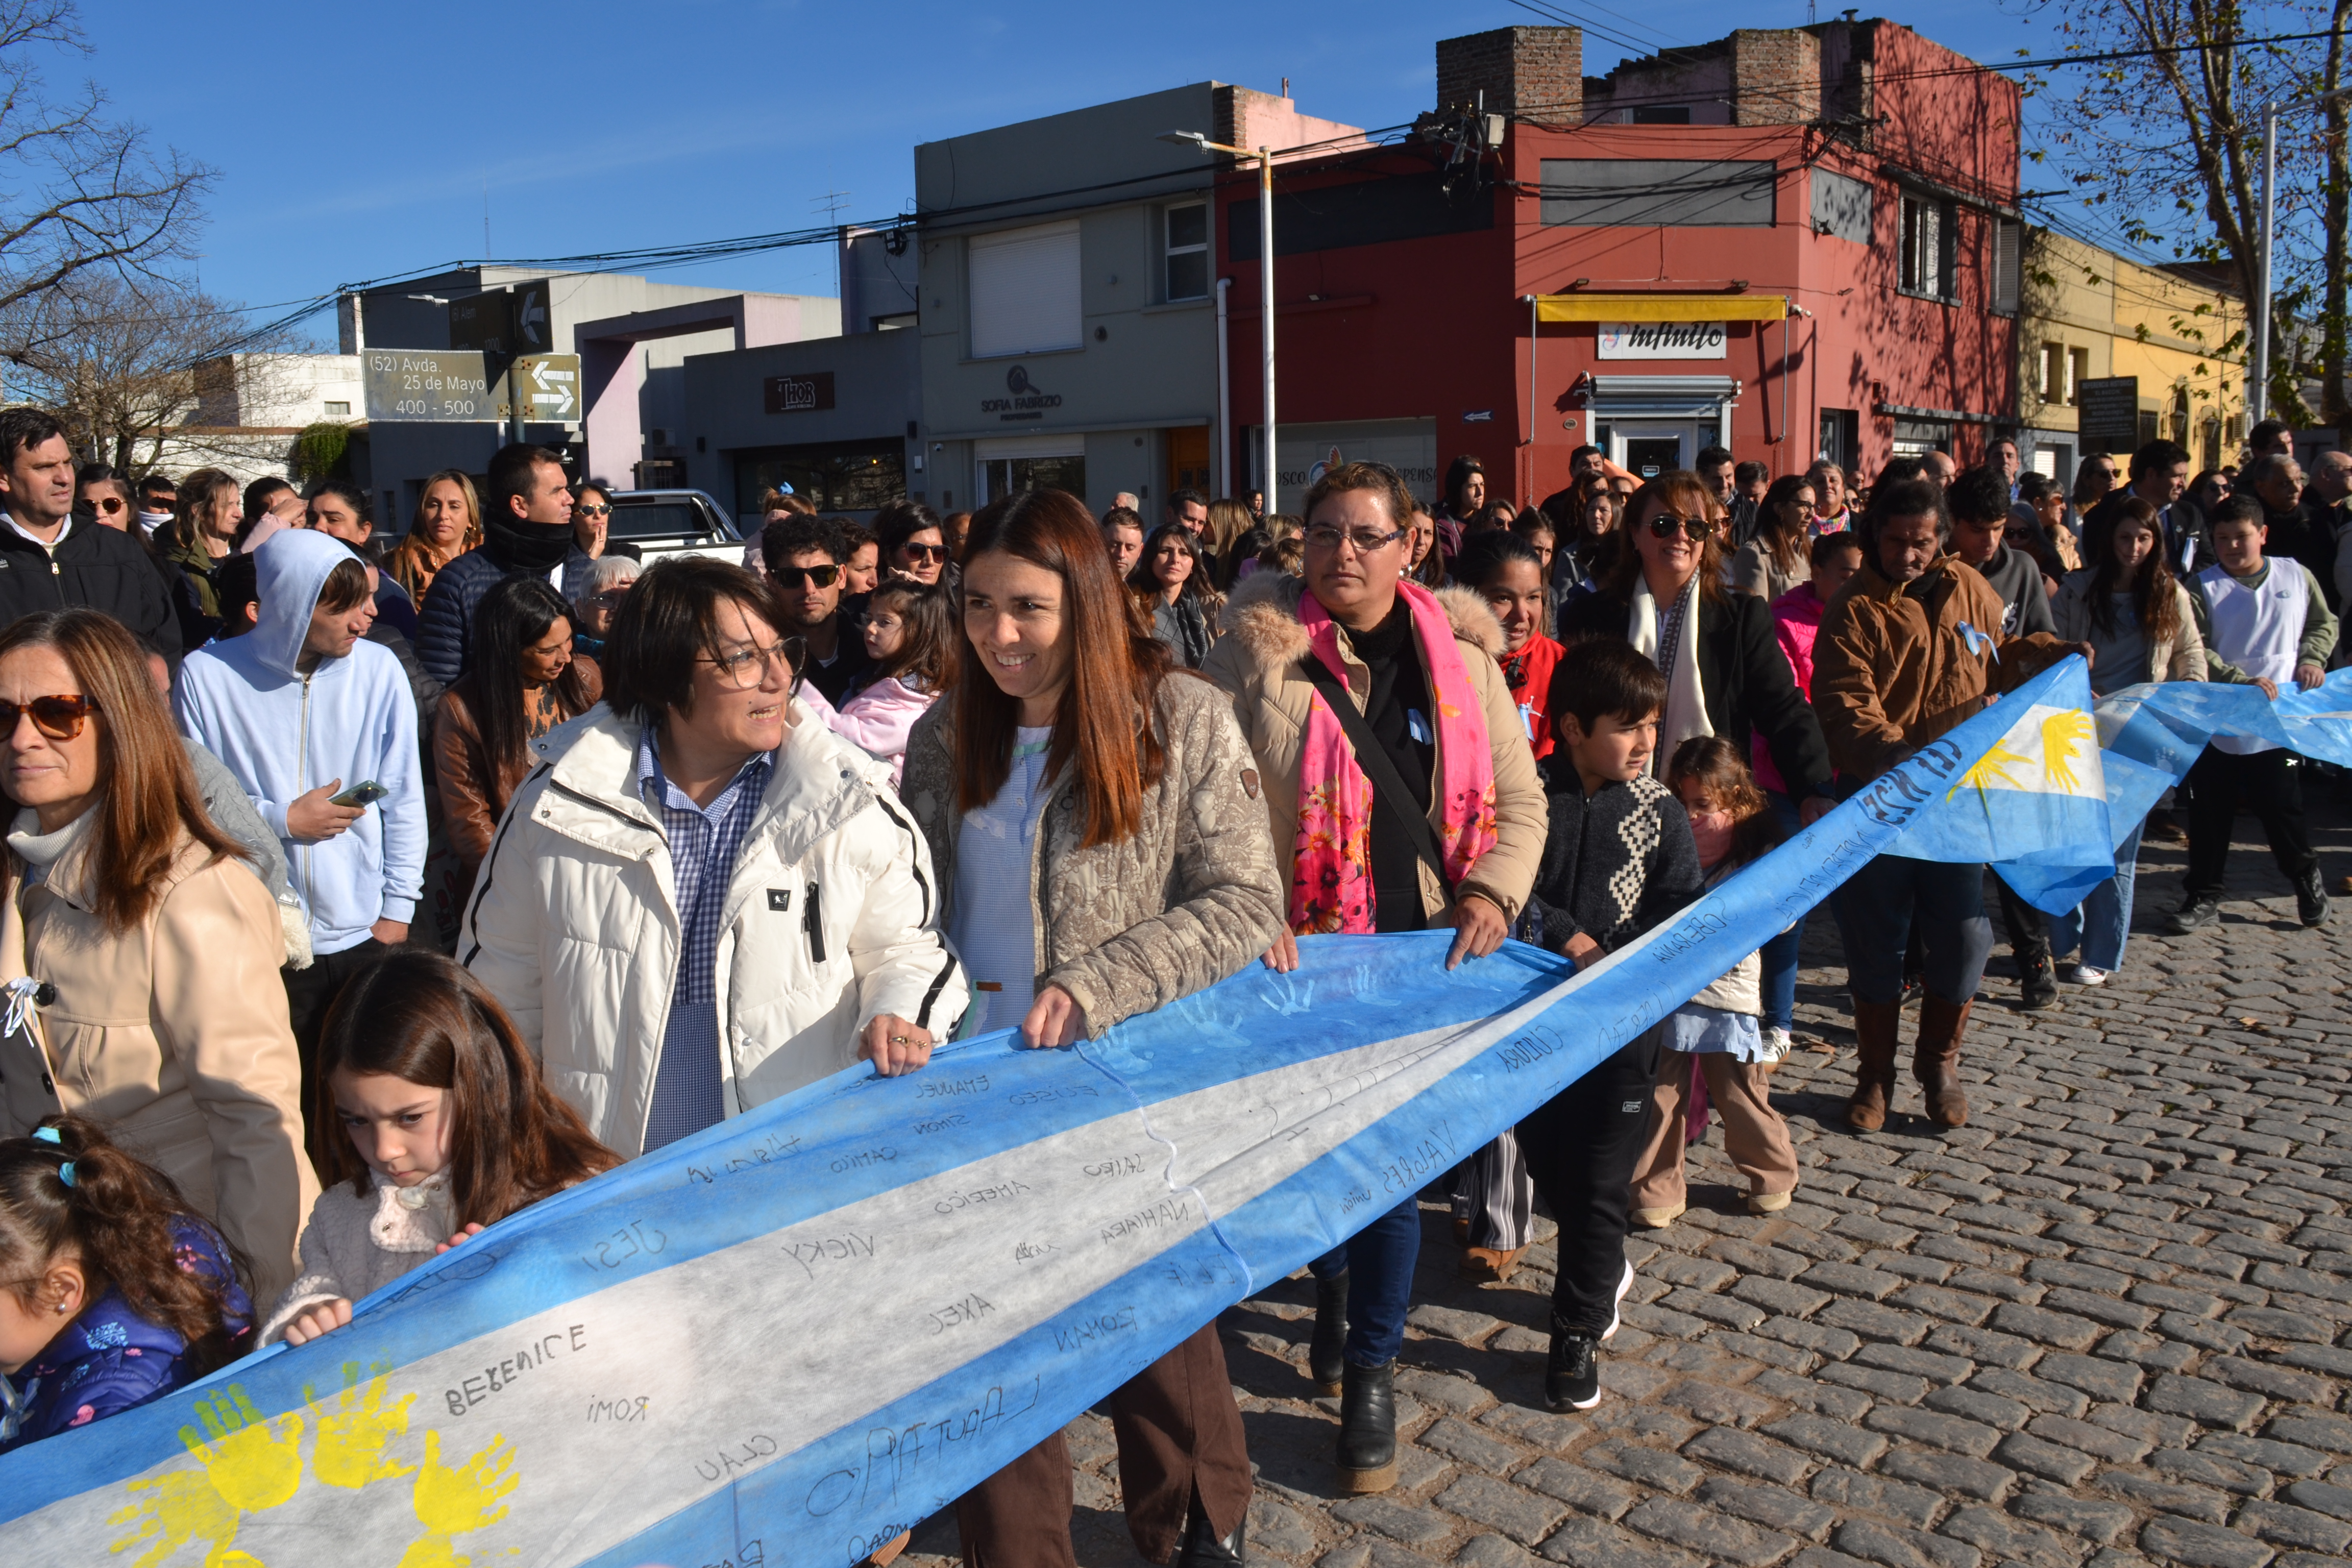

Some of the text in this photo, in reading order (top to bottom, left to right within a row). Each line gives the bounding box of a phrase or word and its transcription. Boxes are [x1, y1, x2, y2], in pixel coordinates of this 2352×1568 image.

[461, 305, 476, 321] Alem
[370, 356, 442, 373] (52) Avda.
[404, 375, 485, 394] 25 de Mayo
[396, 400, 426, 414] 400
[445, 401, 474, 415] 500
[981, 394, 1062, 413] SOFIA FABRIZIO
